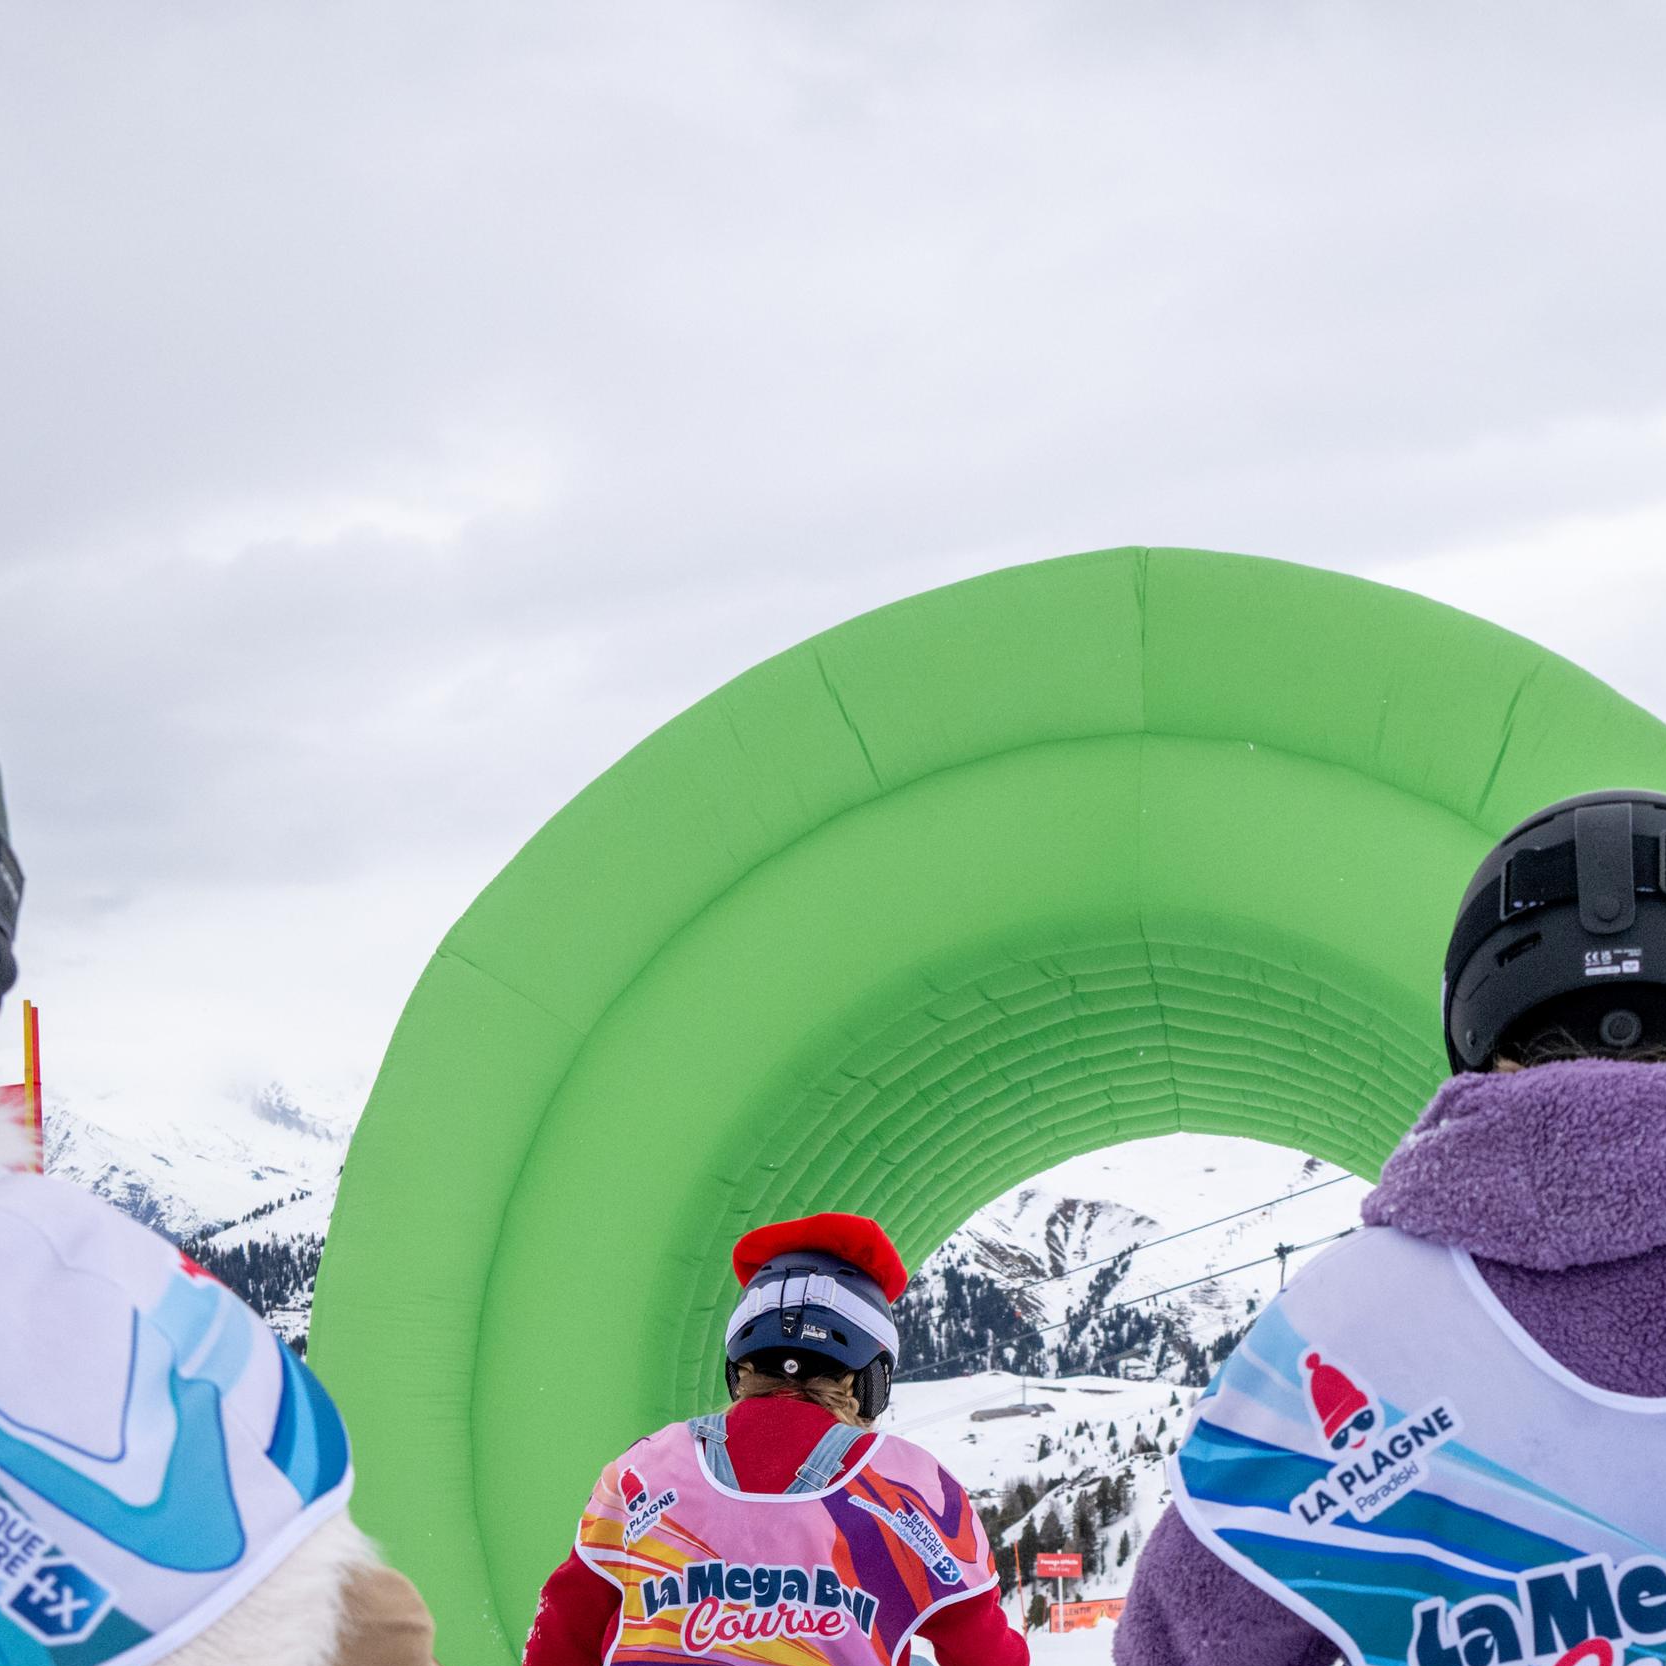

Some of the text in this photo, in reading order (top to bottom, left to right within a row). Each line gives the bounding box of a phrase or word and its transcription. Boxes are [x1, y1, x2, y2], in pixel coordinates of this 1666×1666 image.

[1299, 1406, 1453, 1525] LA PLAGNE
[1355, 1460, 1419, 1512] Paradiski
[630, 1492, 675, 1530] PLAGNE
[896, 1511, 940, 1558] POPULAIRE
[911, 1514, 944, 1552] BANQUE
[643, 1576, 681, 1618] La
[688, 1563, 809, 1607] Mega
[685, 1597, 845, 1651] Course
